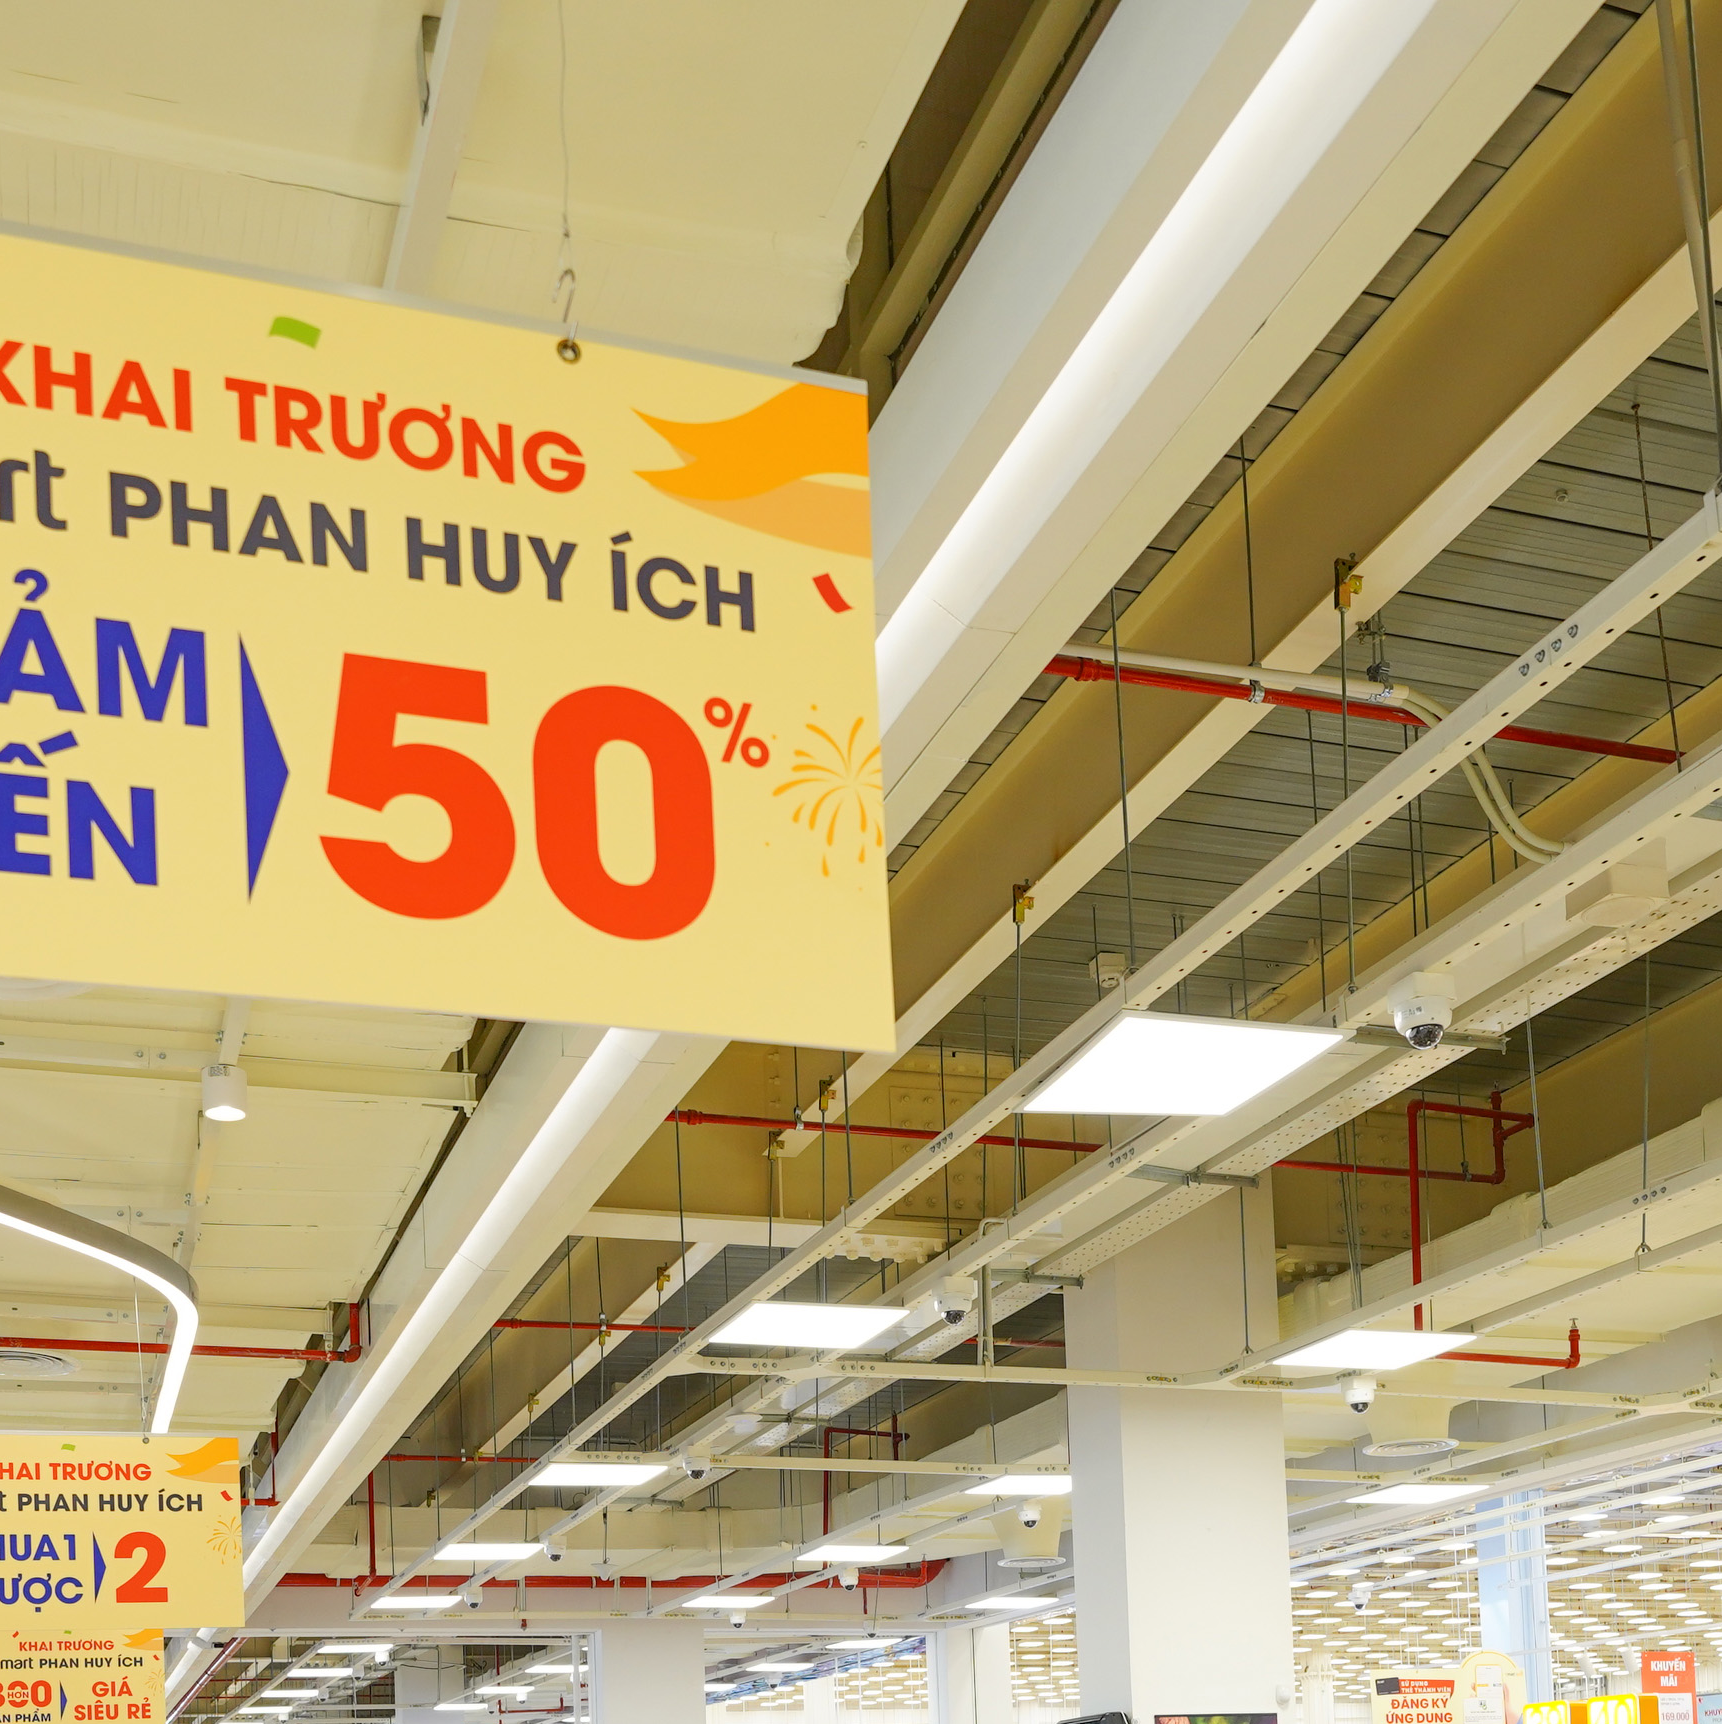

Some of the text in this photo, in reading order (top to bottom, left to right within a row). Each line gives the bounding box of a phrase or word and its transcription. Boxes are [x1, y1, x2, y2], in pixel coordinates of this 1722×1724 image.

[225, 377, 586, 494] TRƯƠNG
[110, 470, 369, 572] PHAN
[406, 516, 578, 600] HUY
[610, 532, 756, 632] ÍCH
[319, 652, 771, 941] 50%
[49, 1460, 152, 1481] TRƯƠNG
[18, 1494, 89, 1512] PHAN
[99, 1494, 151, 1512] HUY
[159, 1488, 202, 1511] ÍCH
[114, 1532, 168, 1604] 2
[19, 1639, 114, 1651] KHAI TRƯƠNG
[40, 1658, 79, 1668] PHAN
[84, 1657, 112, 1667] HUY
[118, 1654, 143, 1667] ÍCH
[1651, 1657, 1686, 1672] KHUYẾN
[92, 1676, 133, 1697] GIÁ
[1660, 1675, 1677, 1687] MÃI
[74, 1697, 151, 1721] SIÊU RẺ
[1391, 1695, 1449, 1709] ĐĂNG KÝ
[15, 1708, 51, 1722] PHẨM
[1386, 1712, 1414, 1724] ỨNG
